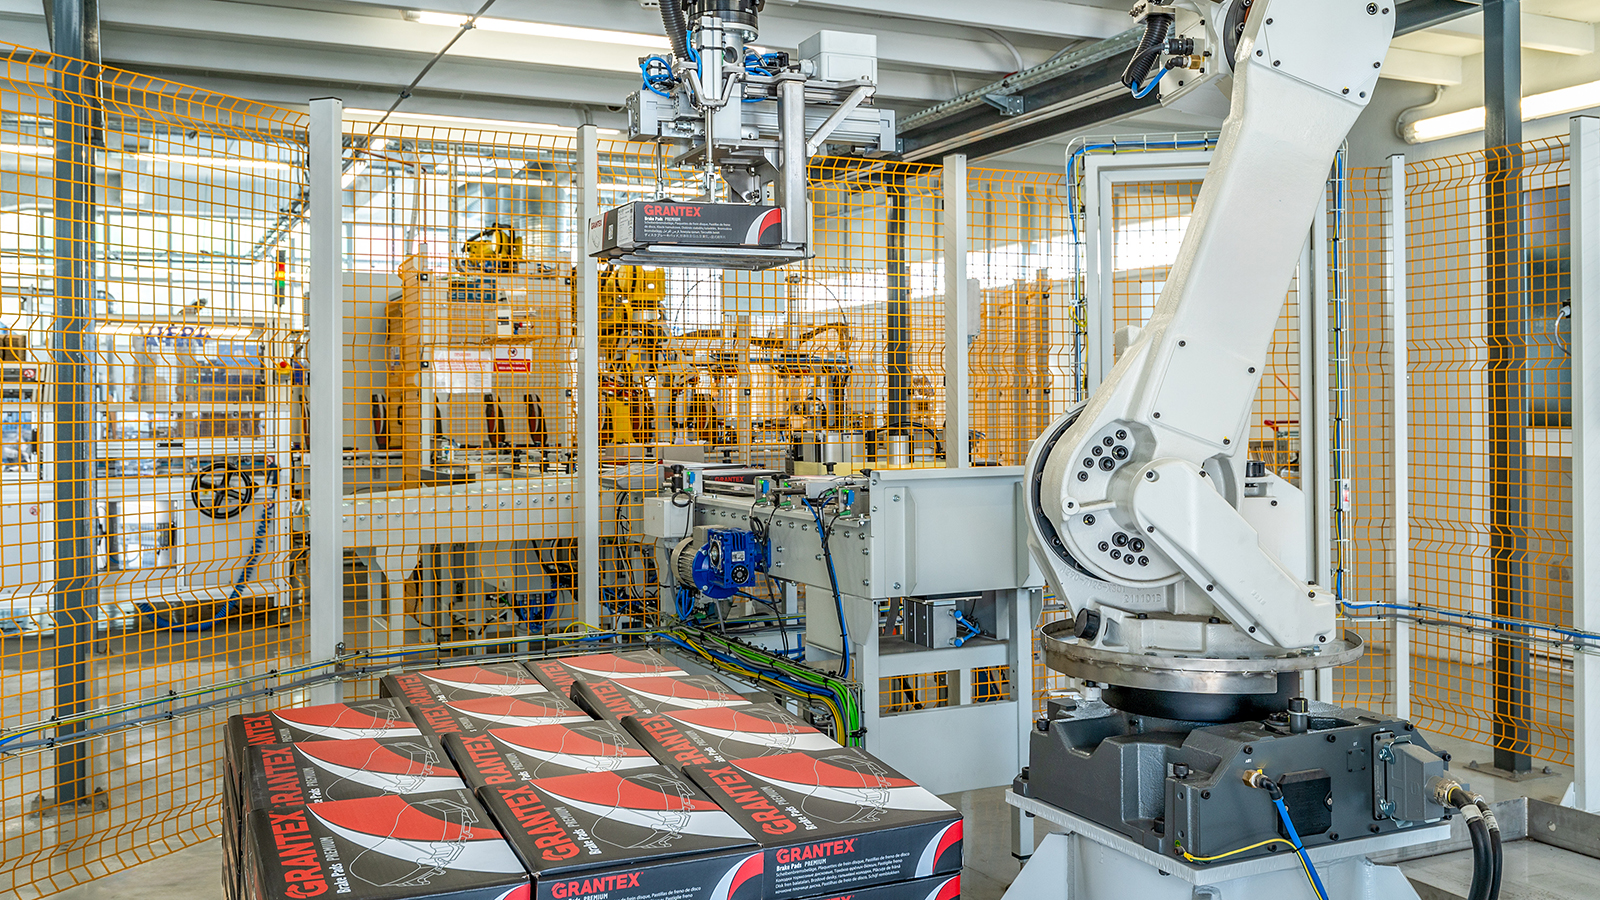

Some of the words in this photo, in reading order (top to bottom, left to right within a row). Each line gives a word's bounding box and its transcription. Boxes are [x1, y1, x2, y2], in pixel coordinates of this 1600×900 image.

[644, 204, 701, 217] GRANTEX
[394, 673, 436, 706] RANTEX
[587, 680, 638, 720] RANTEX
[419, 705, 462, 735] ANTEX
[460, 734, 516, 785] RANTEX
[702, 766, 797, 835] GRANTEX
[760, 786, 790, 806] PREMIUM
[497, 784, 580, 861] GRANTEX
[553, 806, 580, 828] PREMIUM
[785, 805, 803, 817] Pads
[572, 828, 591, 841] Pads
[797, 816, 818, 831] Brake
[268, 809, 329, 899] GRANTEX
[320, 836, 340, 861] PREMIUM
[583, 840, 602, 855] Brake
[776, 838, 856, 864] GRANTEX
[329, 863, 346, 877] Pads
[776, 864, 790, 872] Brake
[804, 858, 827, 867] PREMIUM
[334, 877, 351, 894] Brake
[551, 872, 641, 899] GRANTEX
